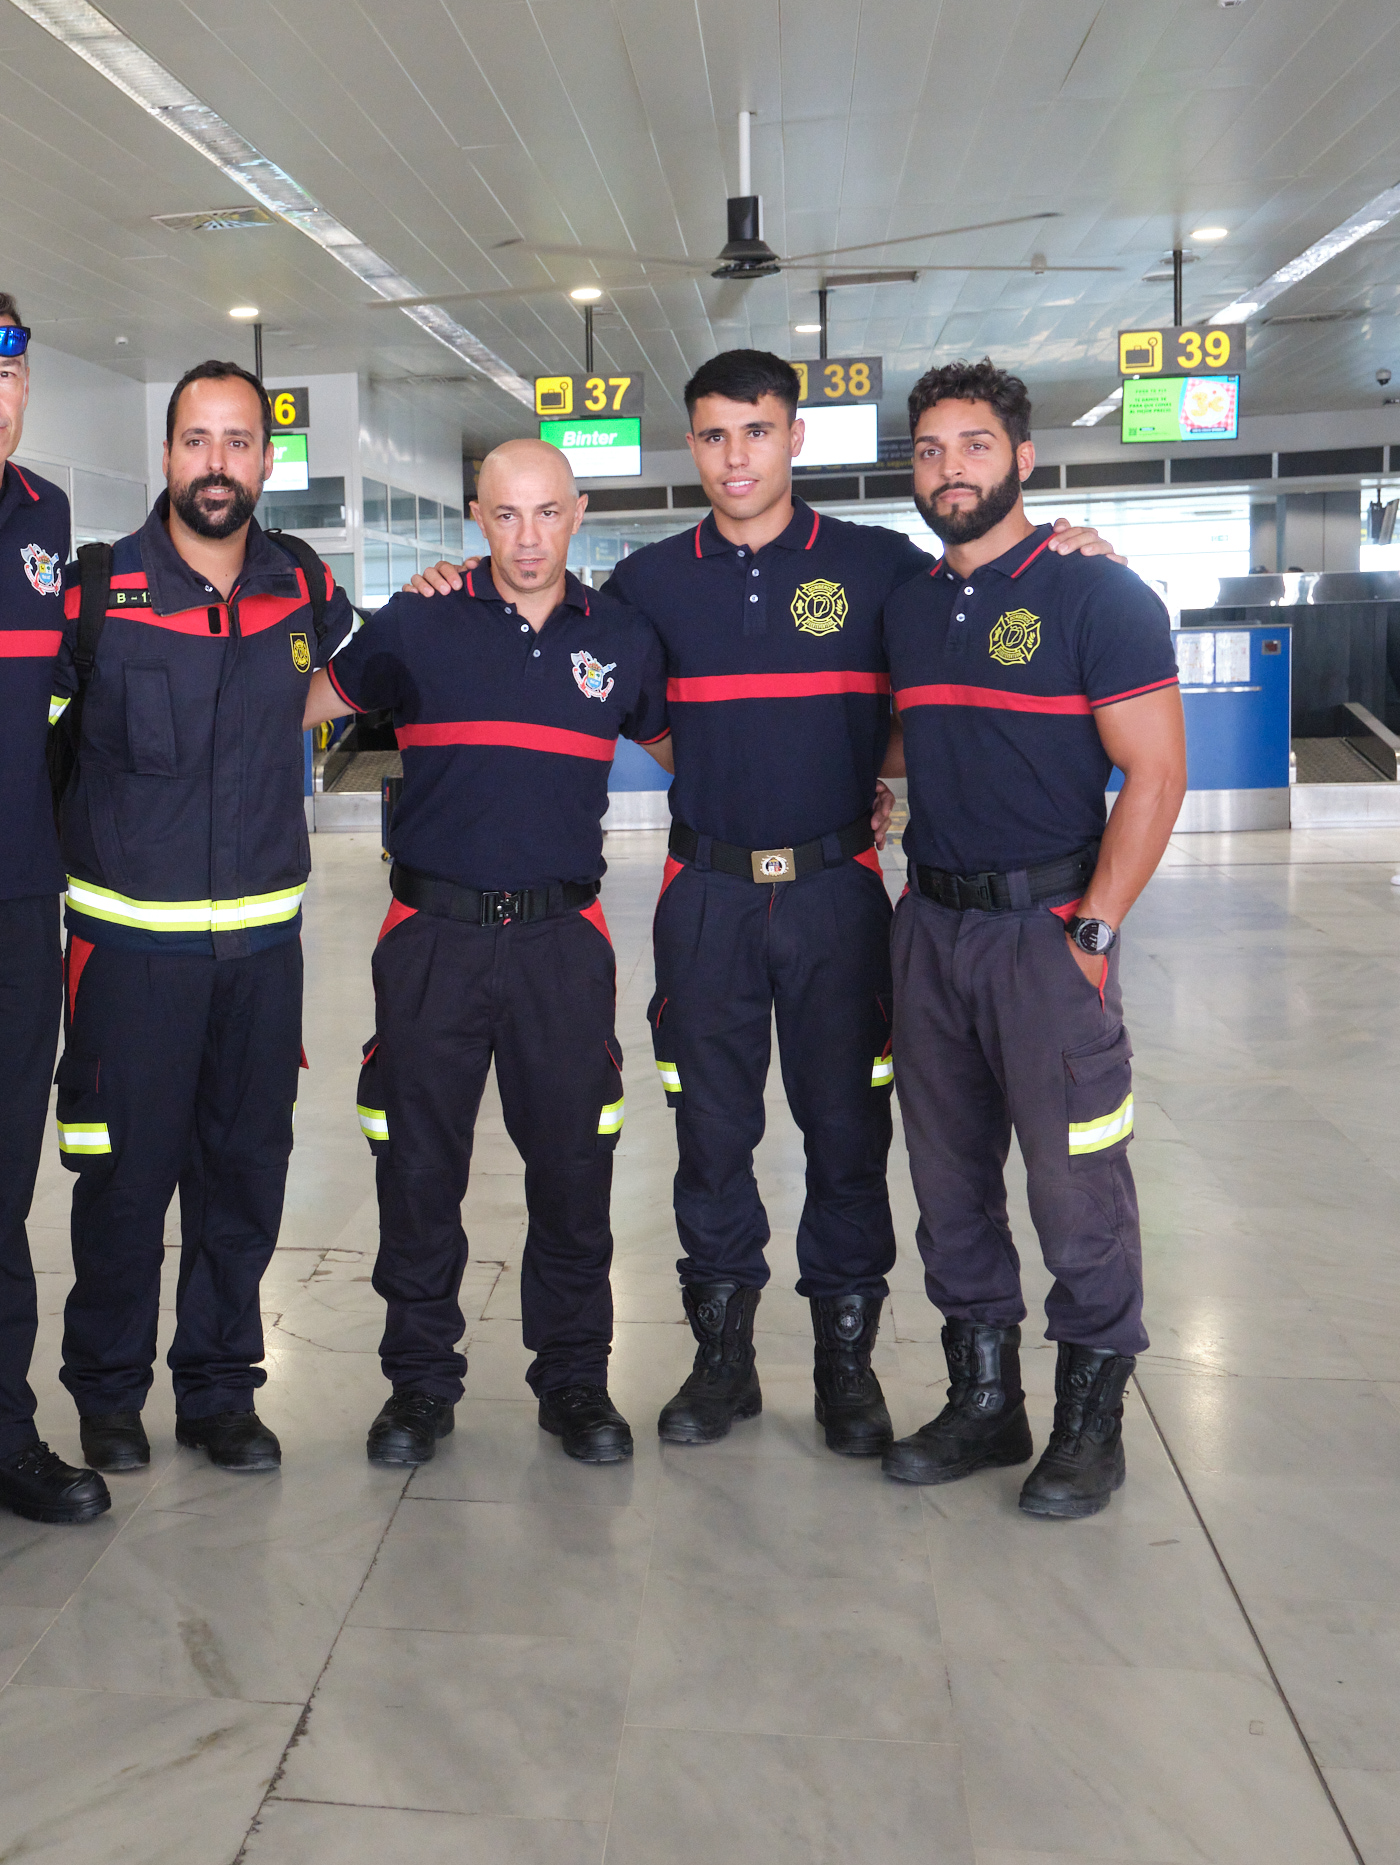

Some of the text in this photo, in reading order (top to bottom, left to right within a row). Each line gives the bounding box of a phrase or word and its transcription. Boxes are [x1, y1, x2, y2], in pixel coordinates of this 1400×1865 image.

[1176, 329, 1231, 369] 39
[584, 377, 632, 412] 37
[823, 362, 872, 399] 38
[562, 430, 618, 447] Binter
